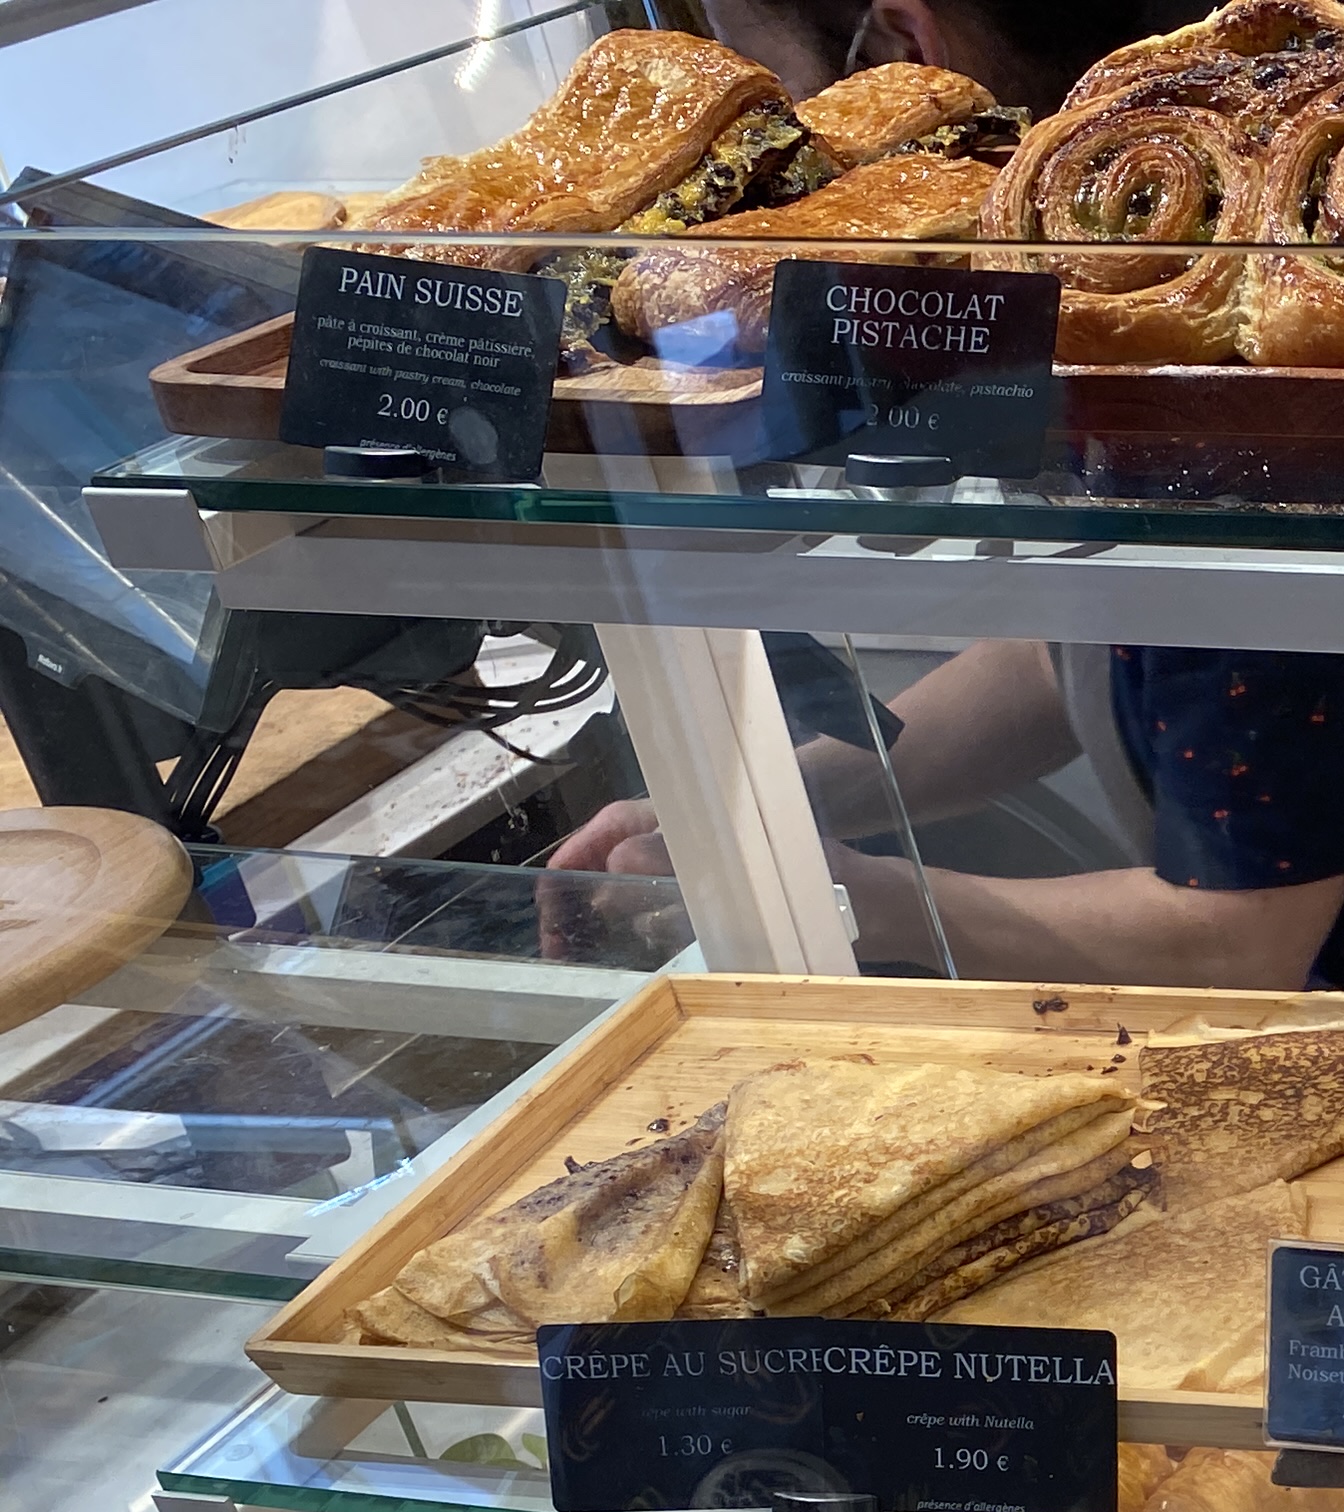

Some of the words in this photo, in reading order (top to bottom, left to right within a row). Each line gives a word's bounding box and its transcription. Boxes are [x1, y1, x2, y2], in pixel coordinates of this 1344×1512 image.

[338, 267, 406, 300] PAIN
[414, 278, 524, 317] SUISSE
[826, 285, 1005, 321] CHOCOLAT
[317, 315, 344, 329] pâte
[360, 322, 422, 342] croissant,
[426, 332, 465, 347] crème
[831, 318, 990, 353] PISTACHE
[347, 335, 393, 353] pépites
[397, 341, 412, 355] de
[415, 345, 470, 363] chocolat
[473, 353, 500, 367] noir
[781, 370, 843, 386] croissant
[970, 384, 1034, 398] pistachio
[377, 394, 430, 421] 2.00
[437, 407, 448, 425] €
[928, 413, 940, 429] €
[542, 1351, 650, 1380] CRÊPE
[662, 1352, 704, 1377] AU
[824, 1344, 942, 1378] CRÊPE
[954, 1352, 1115, 1385] NUTELLA
[907, 1413, 944, 1427] crêpe
[950, 1414, 980, 1427] with
[984, 1415, 1034, 1430] Nutella
[659, 1435, 711, 1456] 1.30
[935, 1447, 988, 1470] 1.90
[997, 1455, 1009, 1471] €
